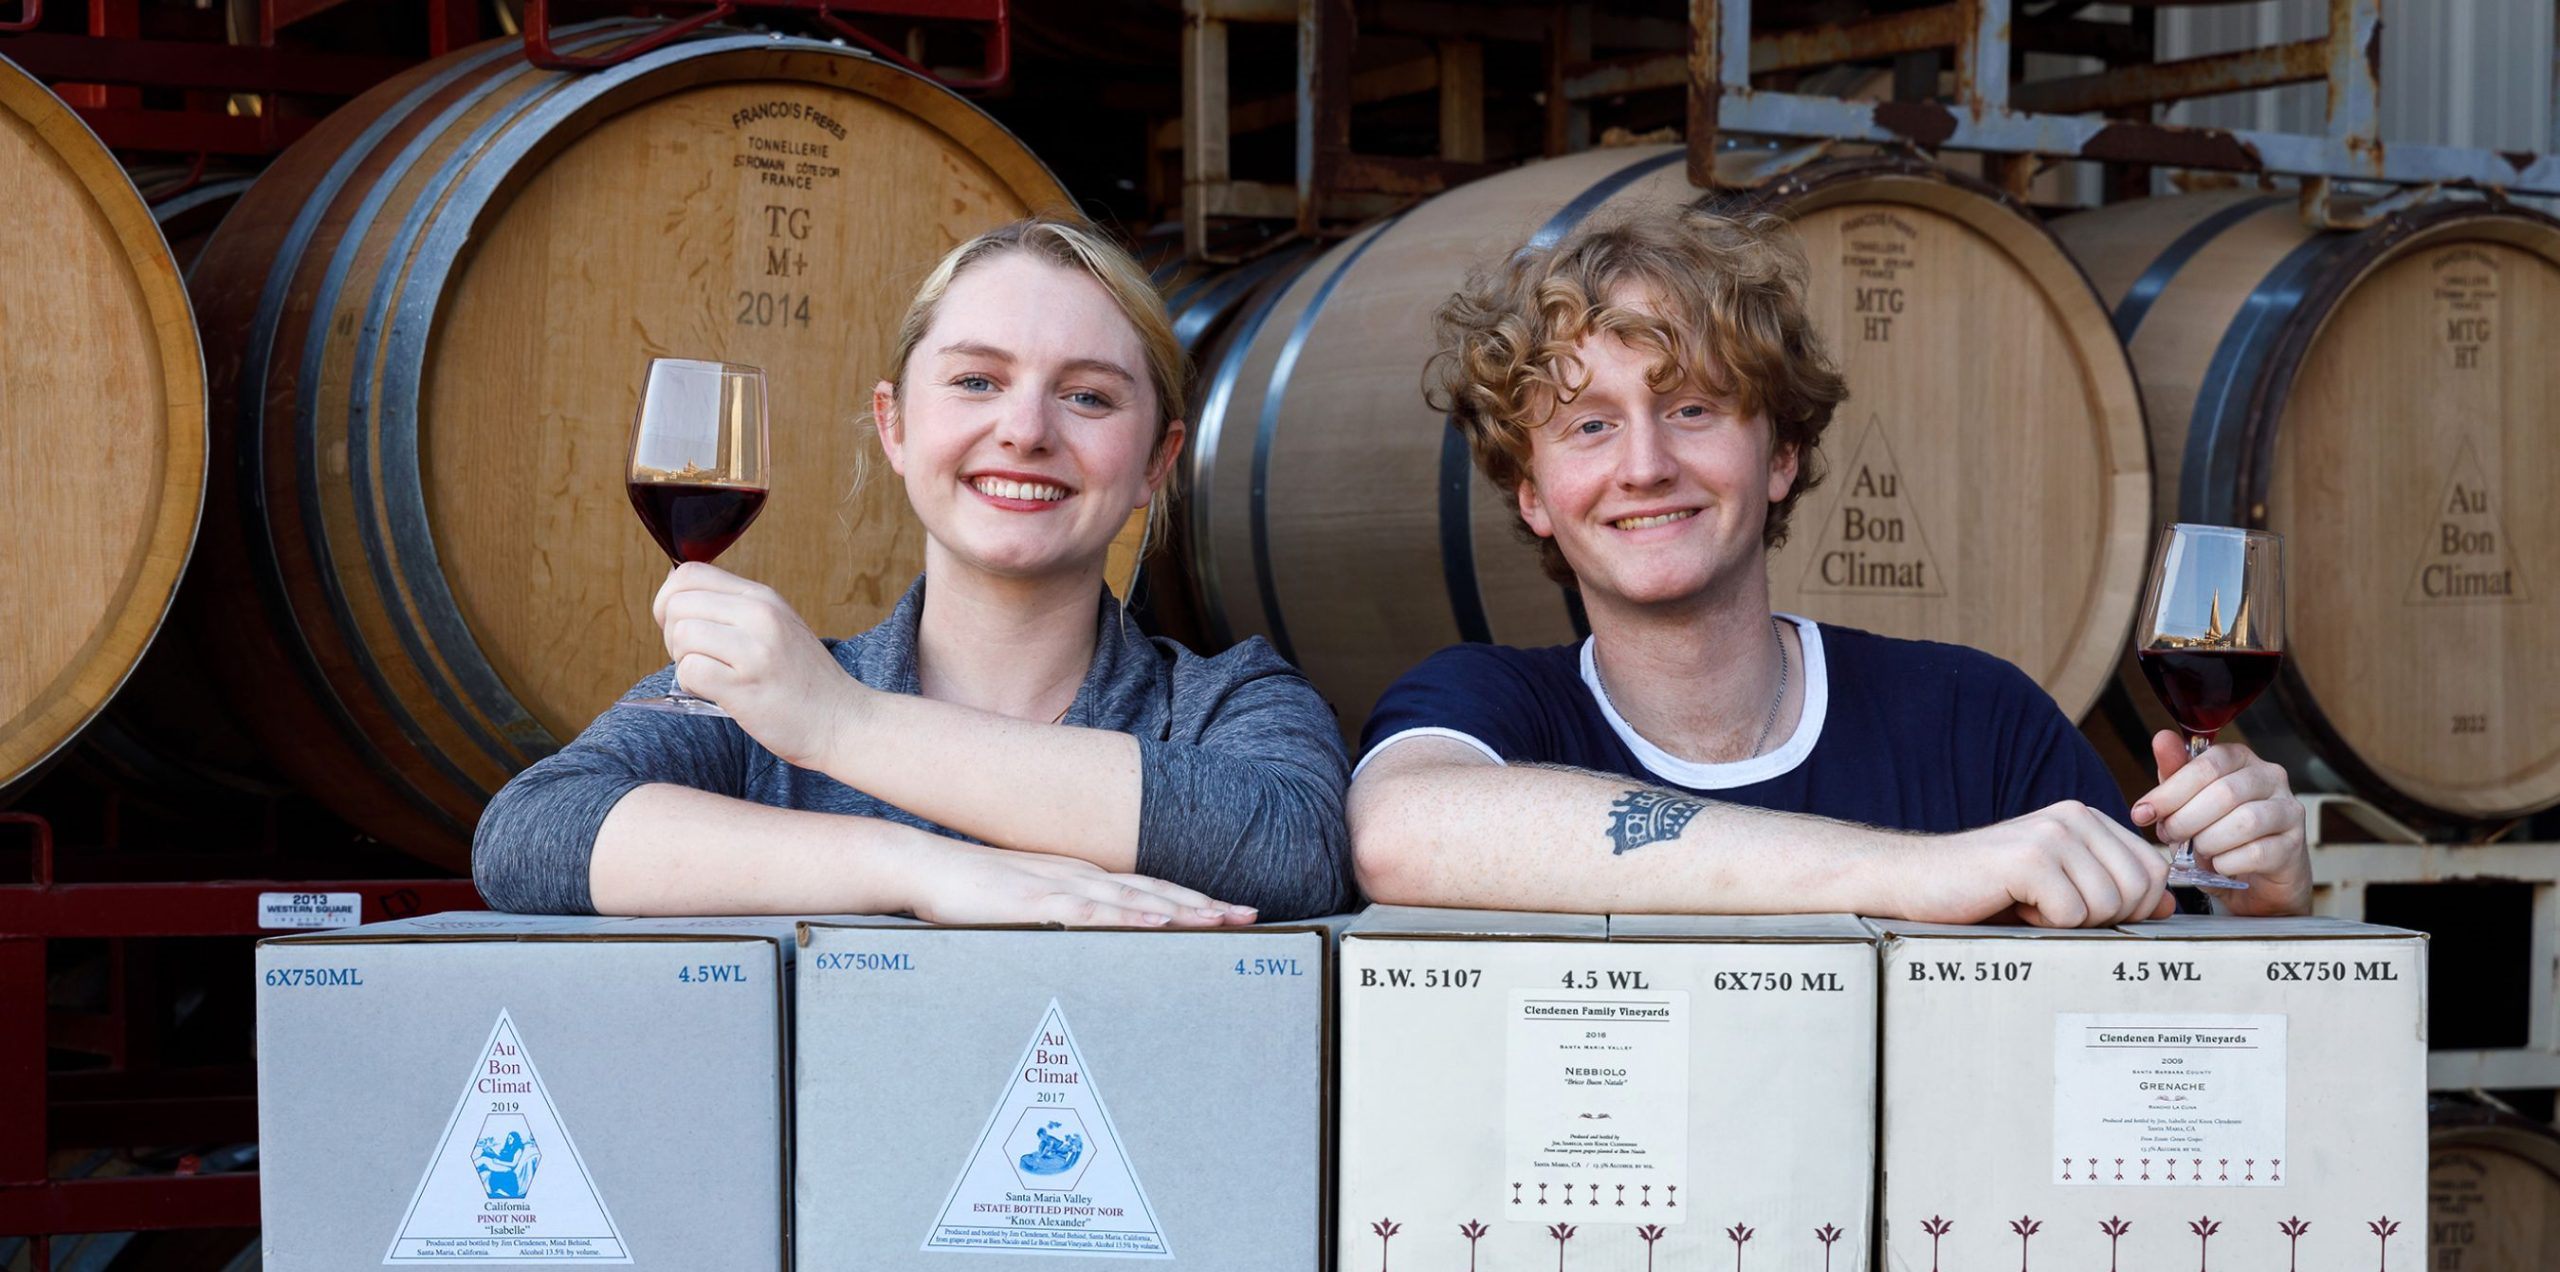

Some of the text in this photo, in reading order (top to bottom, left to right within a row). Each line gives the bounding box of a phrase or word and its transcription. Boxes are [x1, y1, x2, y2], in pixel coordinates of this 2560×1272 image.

[748, 136, 829, 158] TONNELLERIE
[746, 156, 785, 171] ROMAIN
[762, 172, 812, 190] FRANCE
[765, 204, 812, 240] TG
[766, 246, 808, 278] M+
[1855, 286, 1904, 314] MTG
[736, 291, 811, 328] 2014
[1864, 316, 1892, 342] HT
[2446, 318, 2490, 343] MTG
[2455, 344, 2480, 370] HT
[1852, 465, 1896, 498] Au
[2448, 483, 2486, 514] Au
[1844, 507, 1904, 544] Bon
[2440, 522, 2495, 556] Bon
[1821, 552, 1925, 588] Climat
[2422, 564, 2512, 598] Climat
[293, 894, 328, 905] 2013
[816, 953, 916, 972] 6X750ML
[1234, 958, 1303, 976] 4.5WL
[265, 968, 364, 986] 6X750ML
[678, 965, 747, 983] 4.5WL
[1360, 969, 1844, 992] B.W. 5107 4.5 WL 6X750 ML
[1908, 962, 2399, 982] B.W. 5107 4.5 WL 6X750 ML
[1524, 1006, 1670, 1018] Clendenen Family Vineyards
[1040, 1031, 1064, 1046] Au
[2100, 1034, 2246, 1044] Clendenen Family Vineyards
[492, 1042, 516, 1056] Au
[1036, 1050, 1068, 1064] Bon
[489, 1060, 520, 1074] Bon
[1024, 1068, 1078, 1084] Climat
[478, 1078, 532, 1094] Climat
[1037, 1092, 1065, 1102] 2017
[492, 1102, 519, 1112] 2019
[484, 1202, 530, 1211] California
[1006, 1192, 1092, 1206] Santa Maria Valley
[478, 1214, 536, 1223] PINOT NOIR
[974, 1203, 1124, 1216] ESTATE BOTTLED PINOT NOIR
[944, 1228, 970, 1236] Produced
[1001, 1230, 1008, 1238] by
[436, 1249, 456, 1257] Maria,
[566, 1249, 574, 1257] by
[492, 1240, 498, 1248] by
[514, 1240, 548, 1248] Clendenen,
[568, 1240, 592, 1248] Behind,
